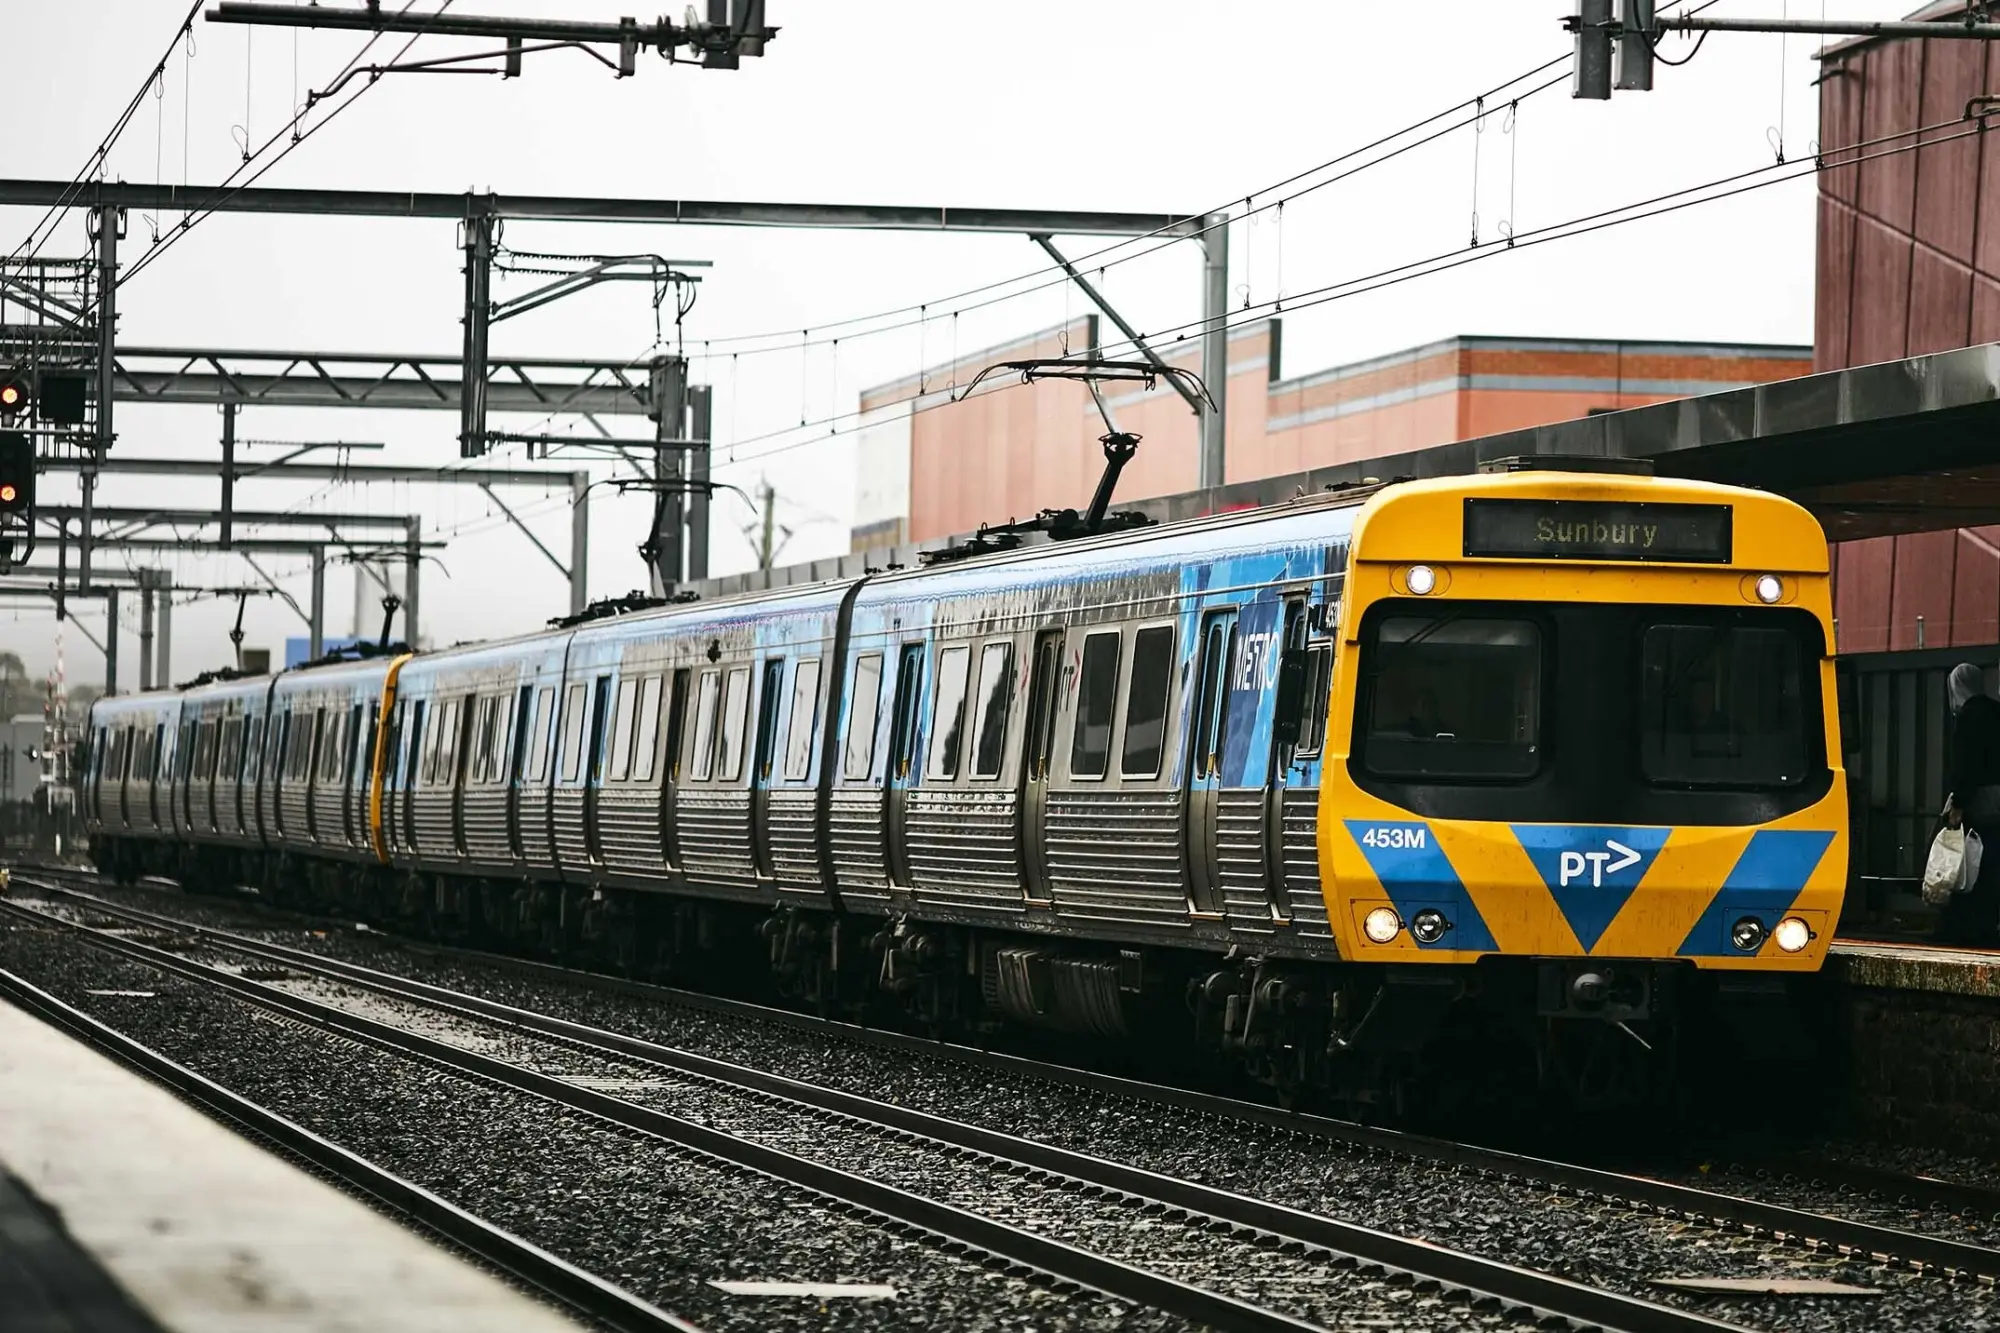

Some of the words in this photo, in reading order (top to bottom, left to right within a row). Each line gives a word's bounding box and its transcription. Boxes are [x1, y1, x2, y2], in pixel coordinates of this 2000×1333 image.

[1536, 518, 1657, 548] Sunbury
[1232, 632, 1281, 691] METRO
[1362, 827, 1426, 850] 453M
